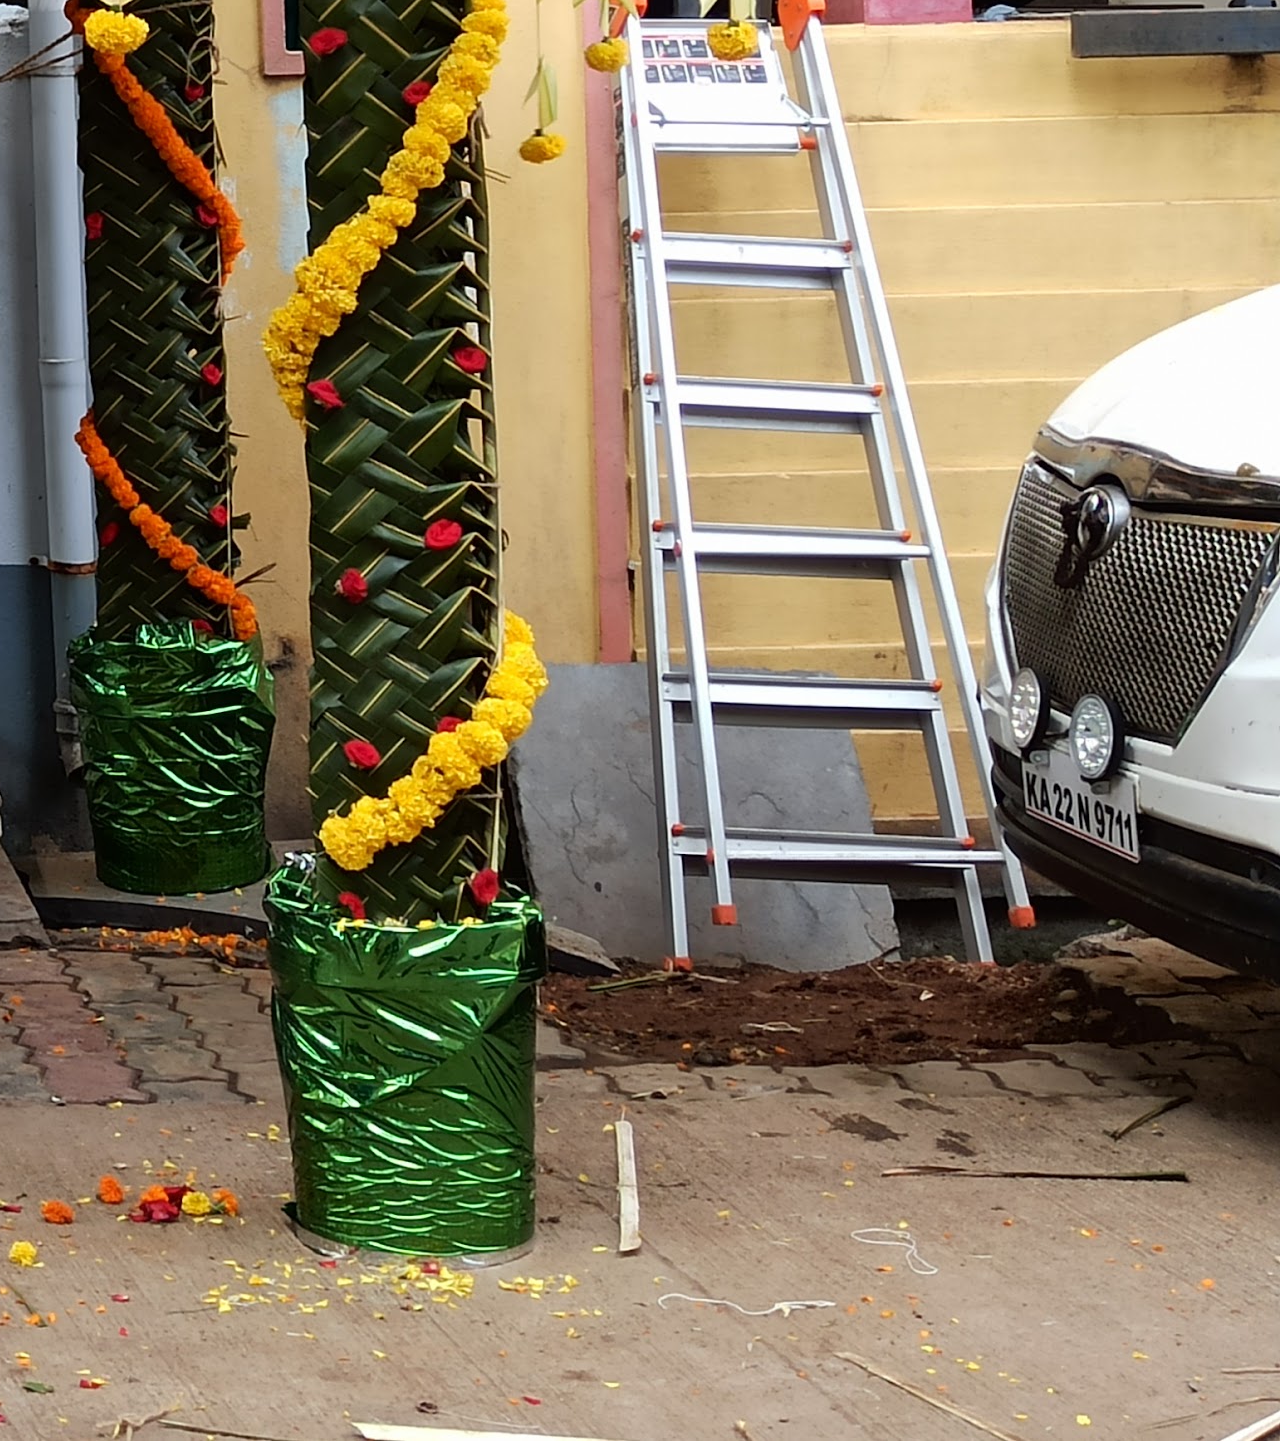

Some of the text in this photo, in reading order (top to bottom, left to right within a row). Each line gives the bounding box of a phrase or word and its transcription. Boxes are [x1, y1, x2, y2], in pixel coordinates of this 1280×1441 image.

[1026, 770, 1134, 852] KA 22 N 9711
